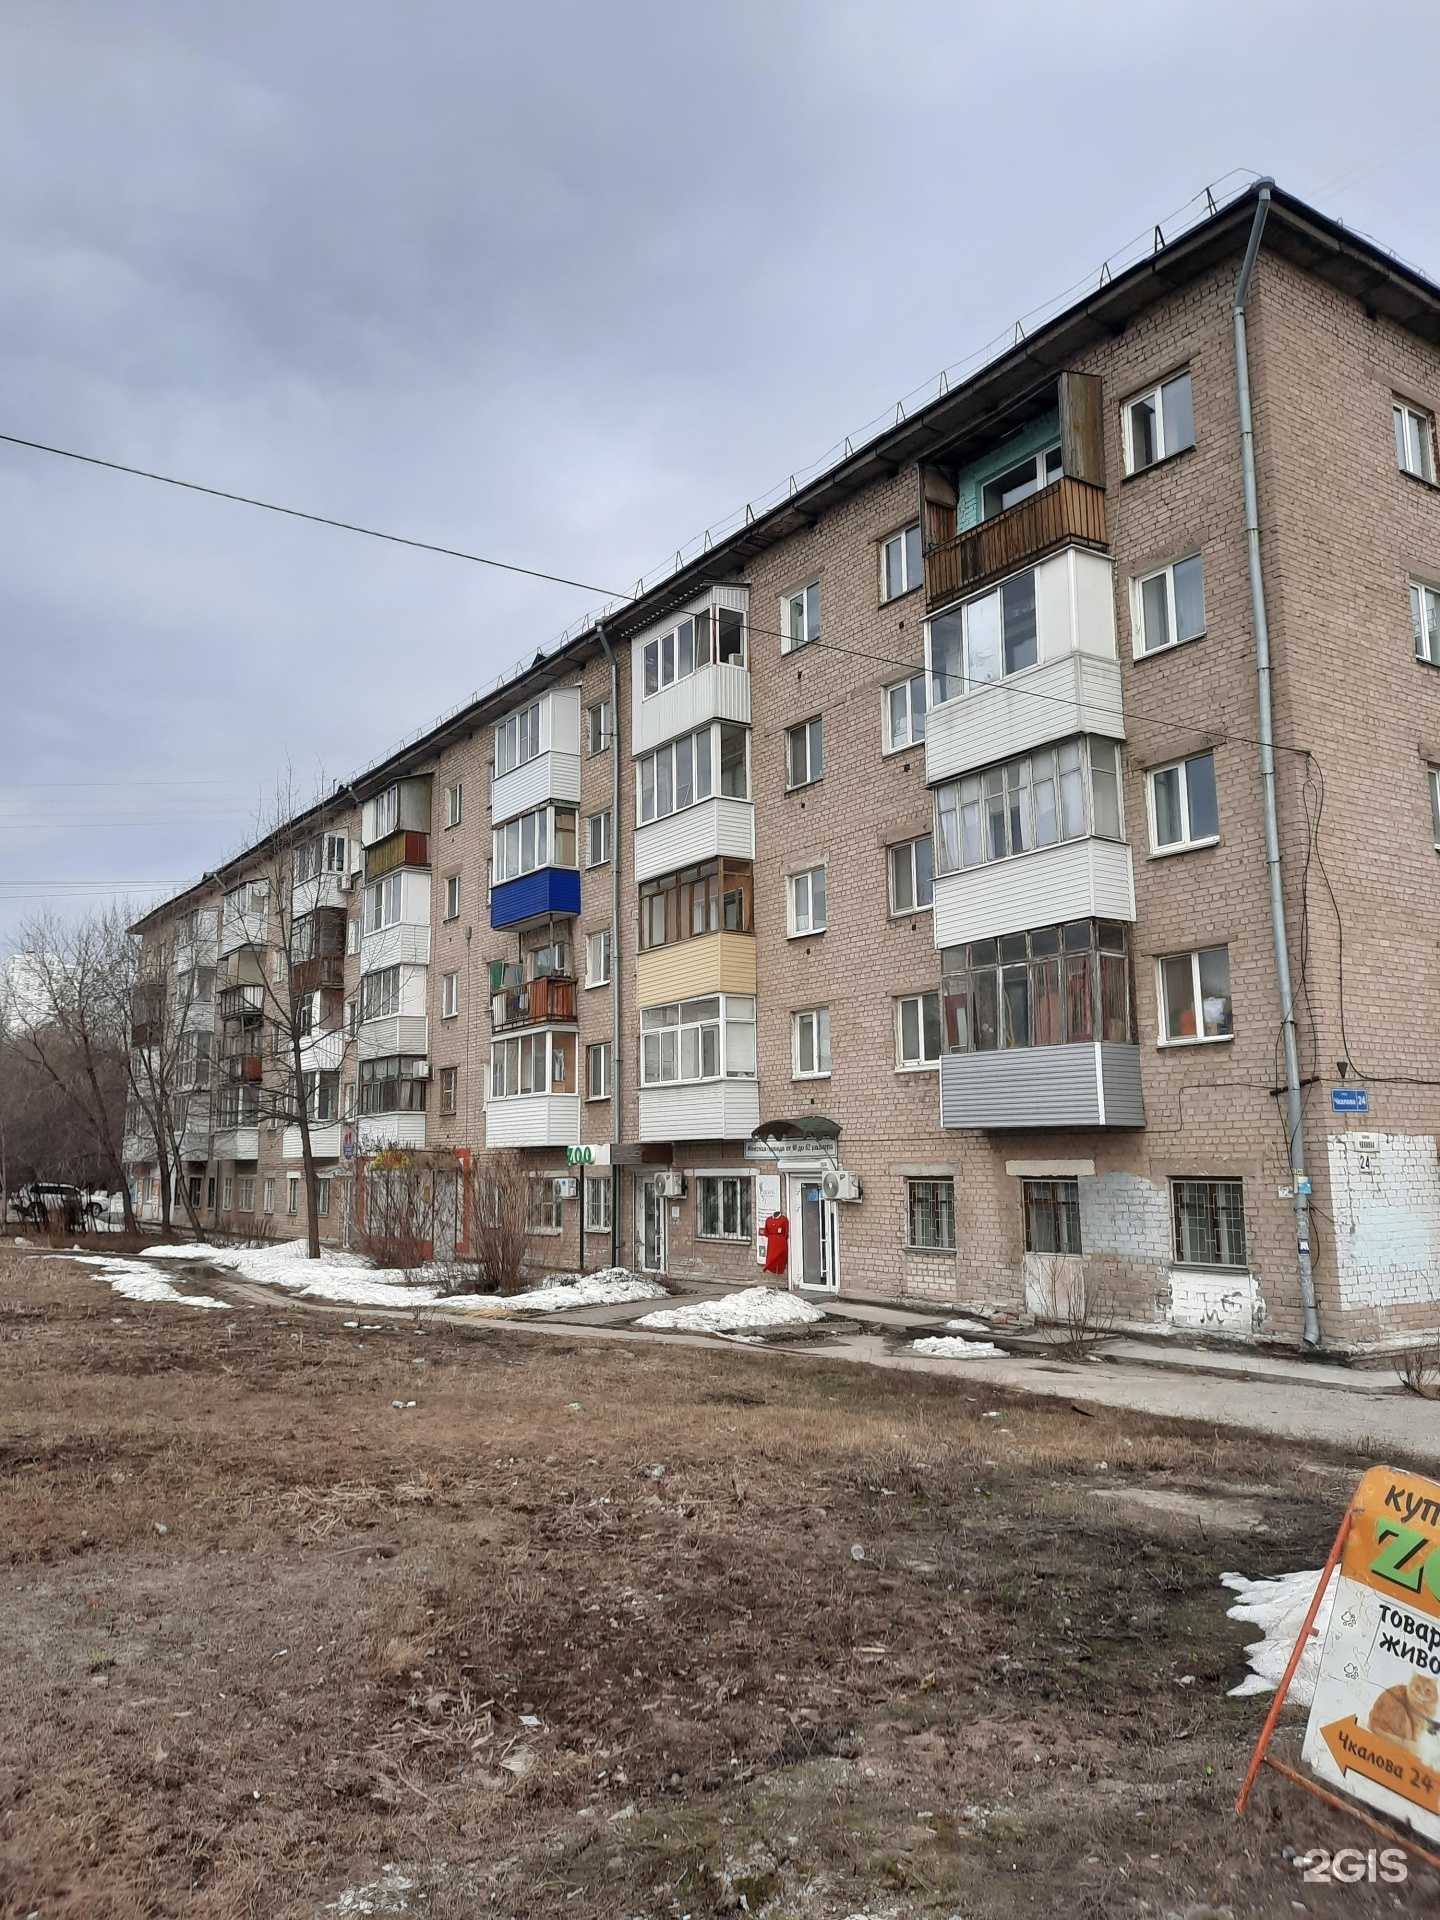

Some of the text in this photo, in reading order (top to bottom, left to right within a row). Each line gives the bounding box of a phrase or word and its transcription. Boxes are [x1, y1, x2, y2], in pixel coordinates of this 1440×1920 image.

[1358, 1095, 1366, 1105] 24
[1360, 1155, 1370, 1169] 24
[1338, 1730, 1434, 1793] Чкалова 24
